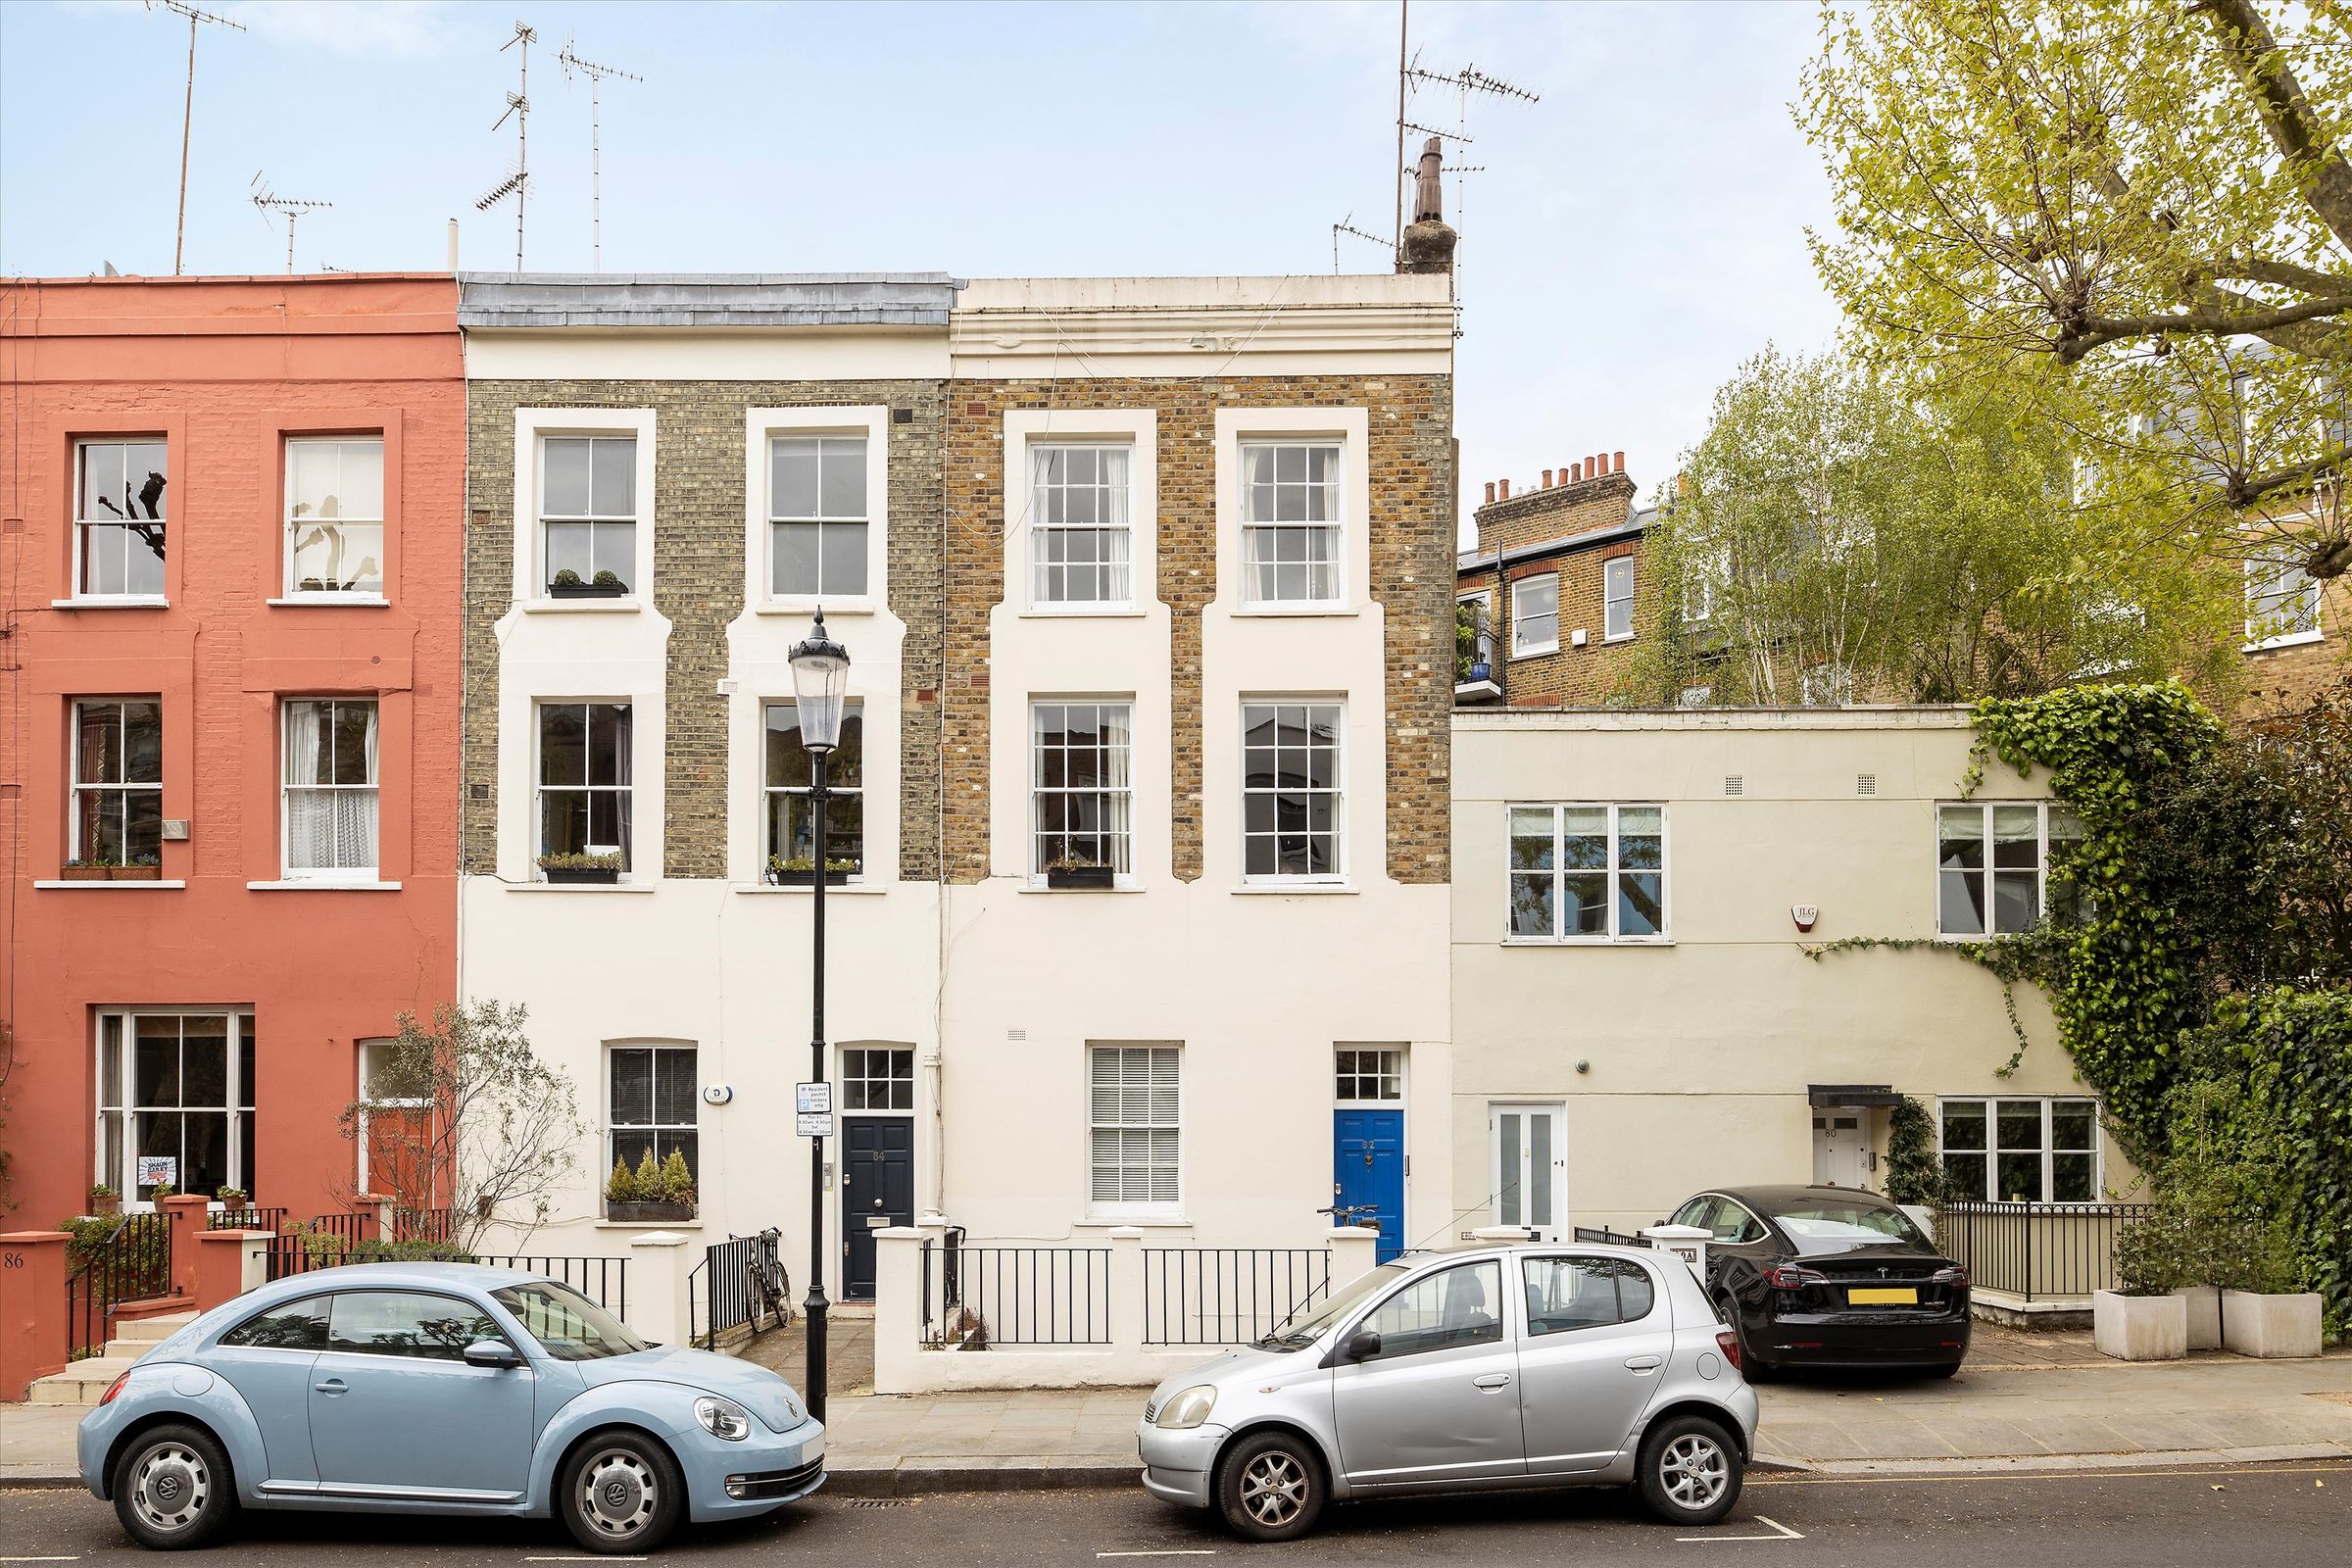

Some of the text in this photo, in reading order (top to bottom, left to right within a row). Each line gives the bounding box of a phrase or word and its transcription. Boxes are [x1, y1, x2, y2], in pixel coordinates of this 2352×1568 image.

[1797, 907, 1814, 917] JLG
[1363, 1141, 1375, 1150] 82
[873, 1151, 885, 1161] 84
[4, 1252, 24, 1269] 86
